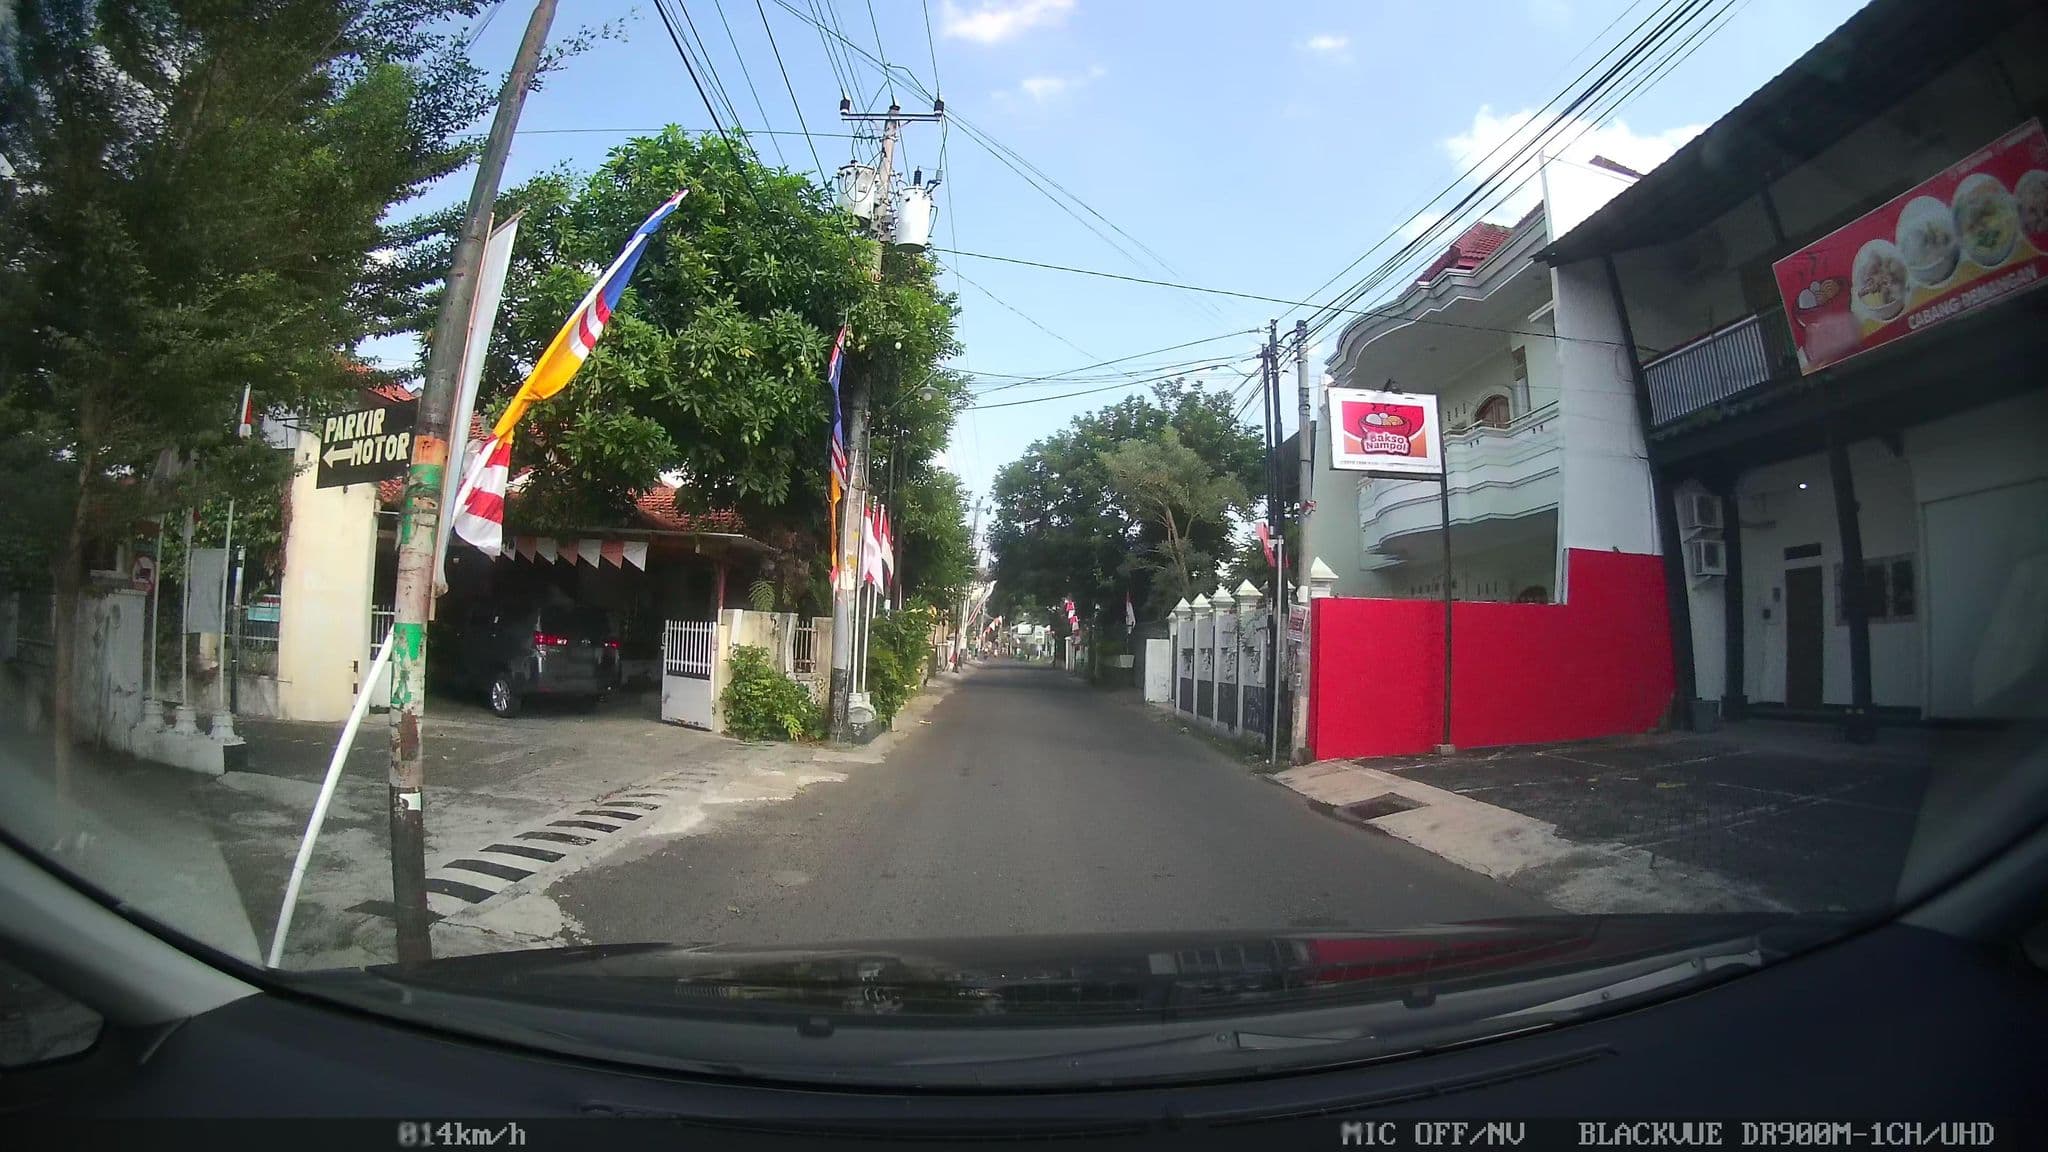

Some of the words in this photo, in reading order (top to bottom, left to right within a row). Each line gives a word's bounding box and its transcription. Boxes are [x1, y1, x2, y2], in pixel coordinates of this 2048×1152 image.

[1908, 297, 1962, 329] CABANG
[324, 408, 385, 443] PARKIR
[350, 432, 410, 466] MOTOR
[1366, 441, 1406, 451] Nampol
